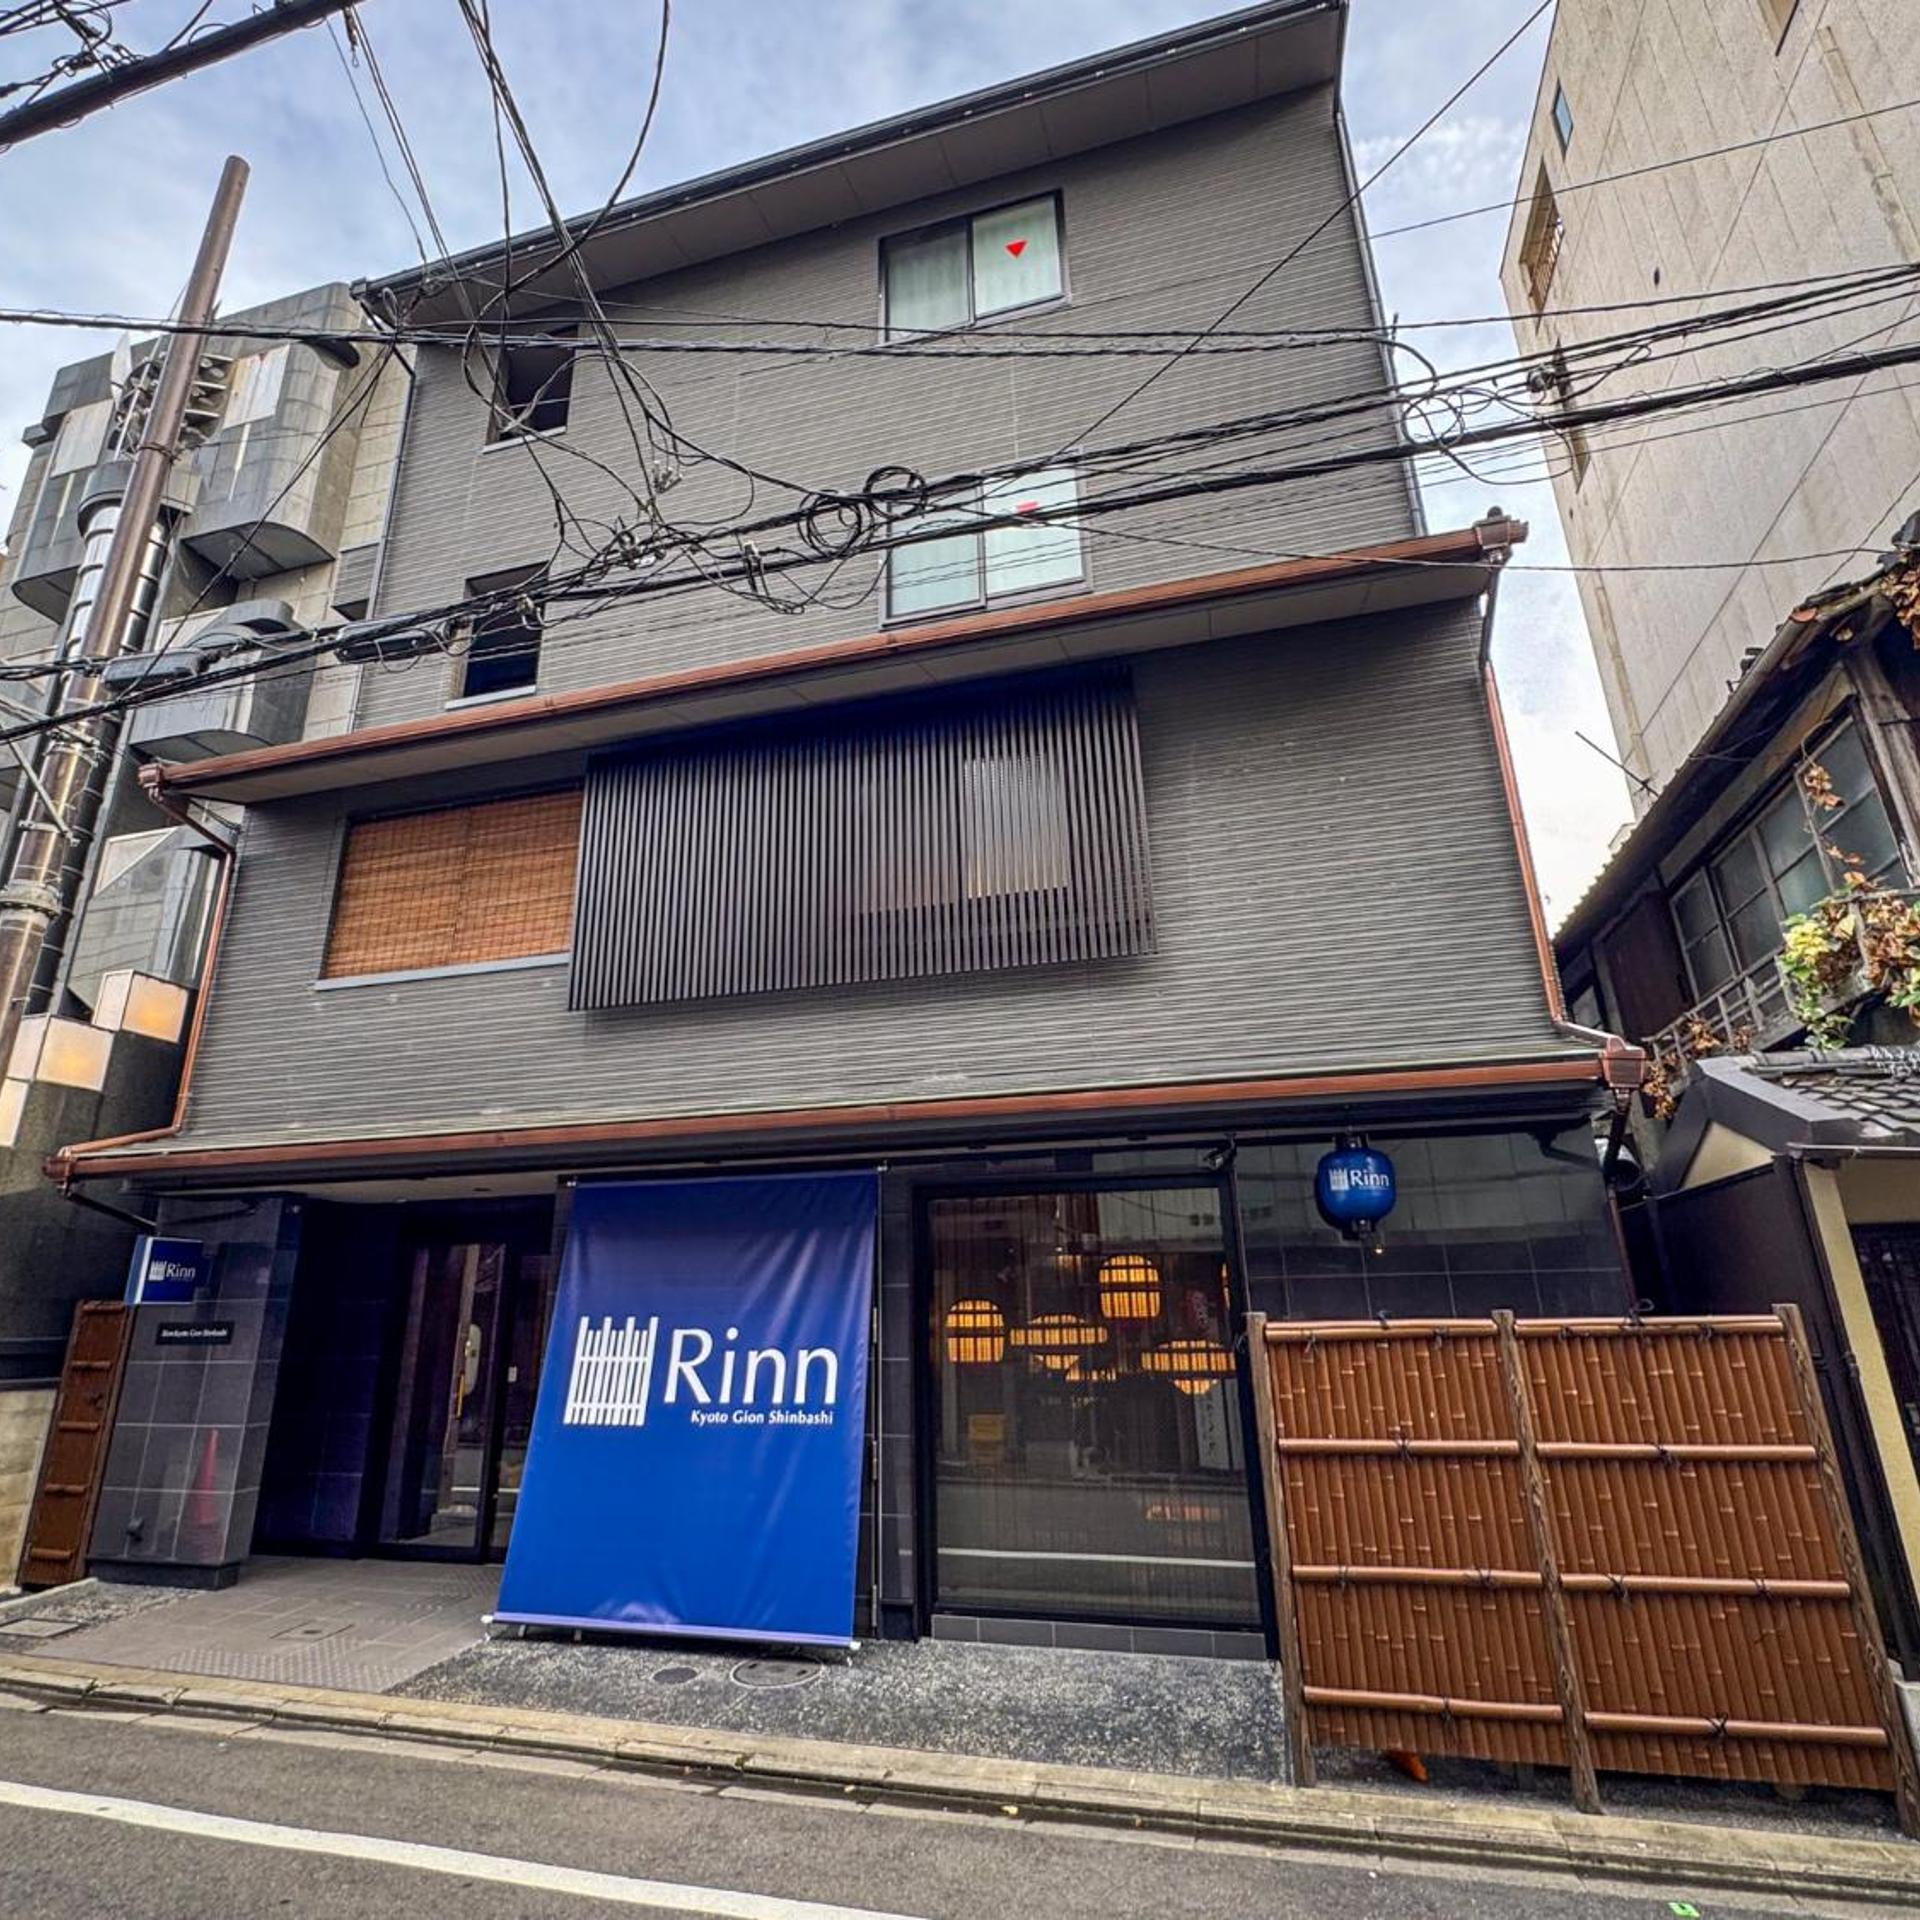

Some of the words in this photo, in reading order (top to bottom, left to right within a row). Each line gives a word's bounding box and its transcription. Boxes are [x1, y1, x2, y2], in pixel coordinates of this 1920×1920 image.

[1350, 1170, 1390, 1187] Rinn
[166, 1263, 196, 1278] Rinn
[664, 1327, 838, 1404] Rinn
[691, 1410, 728, 1426] Kyoto
[732, 1409, 764, 1424] Gion
[768, 1410, 833, 1425] Shinbashi
